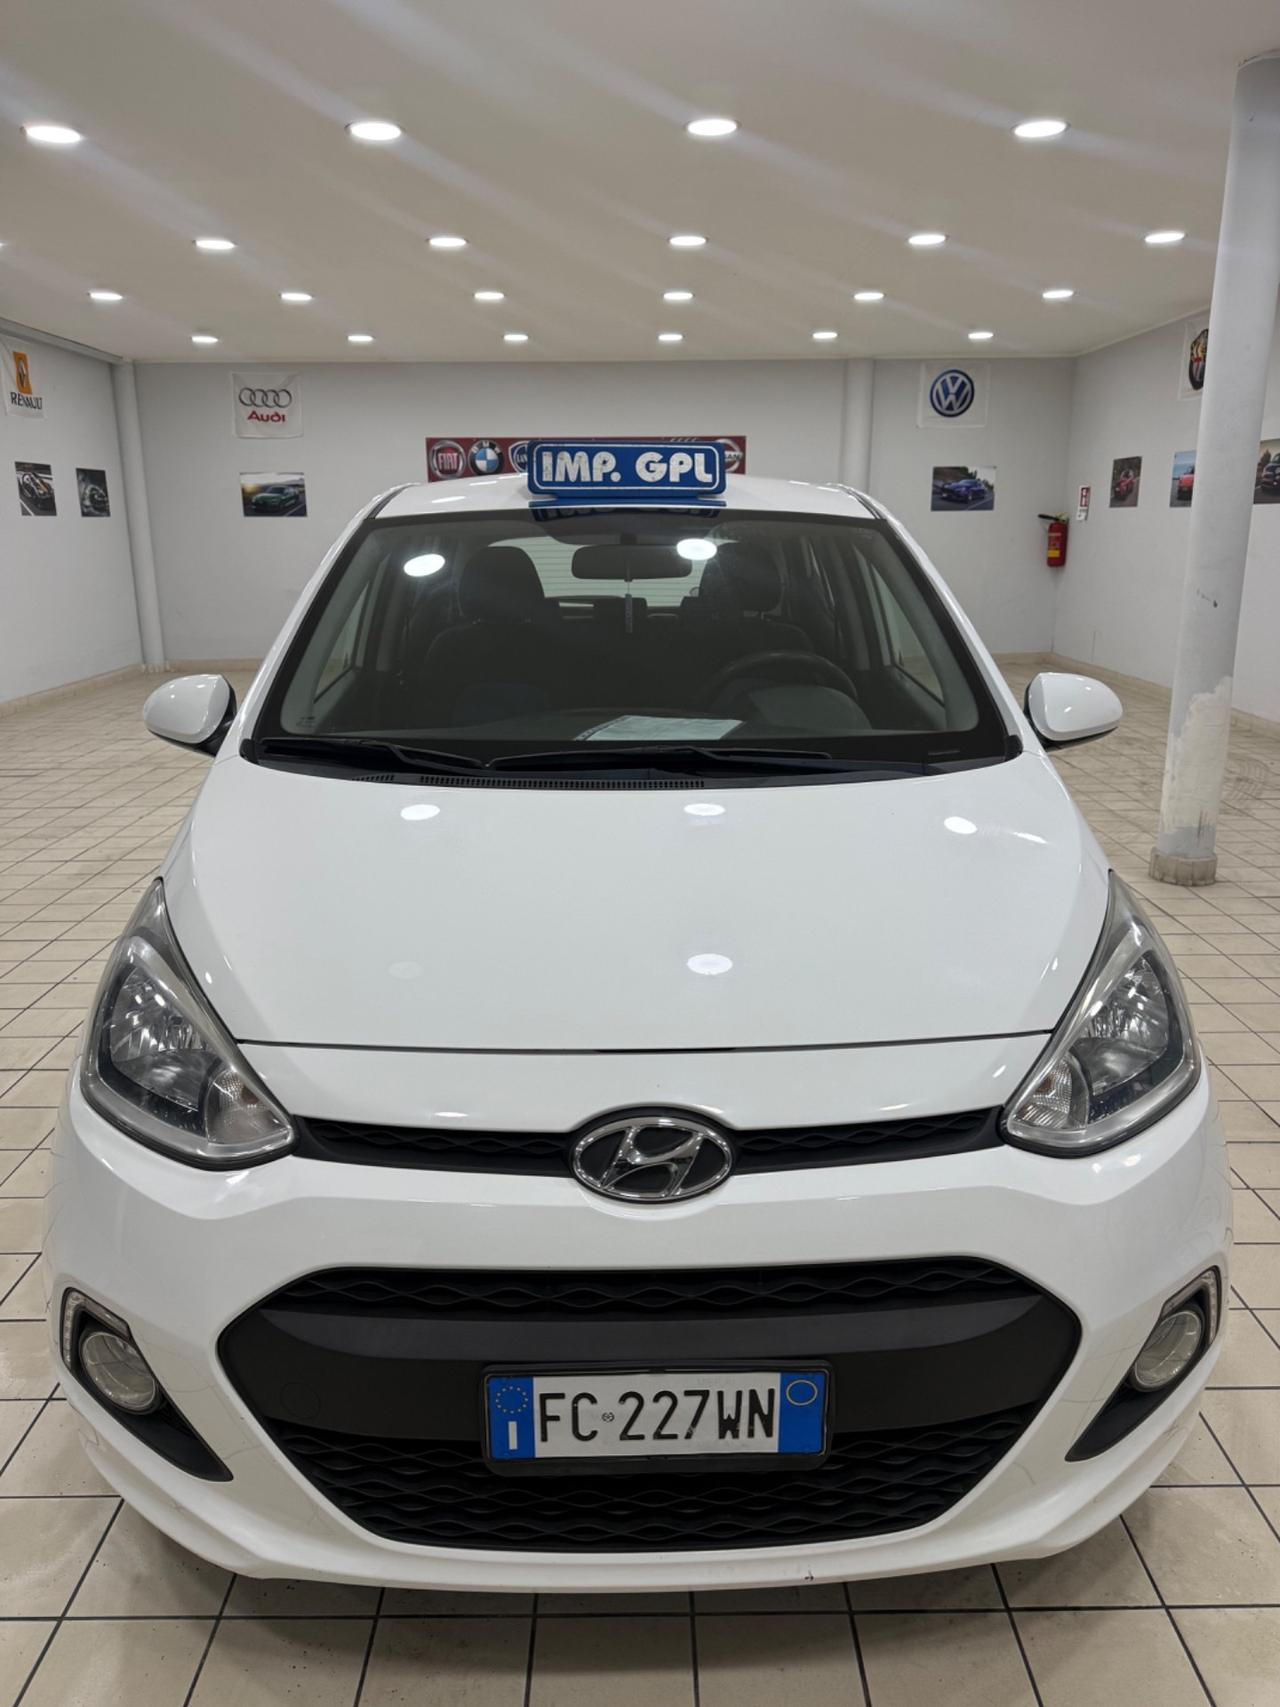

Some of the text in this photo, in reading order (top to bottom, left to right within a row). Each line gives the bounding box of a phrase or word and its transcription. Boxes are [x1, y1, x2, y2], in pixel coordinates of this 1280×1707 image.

[247, 410, 286, 423] Audi
[437, 452, 458, 470] FIAT
[542, 451, 713, 483] IMP. GPL
[539, 1388, 775, 1442] FC 227WN
